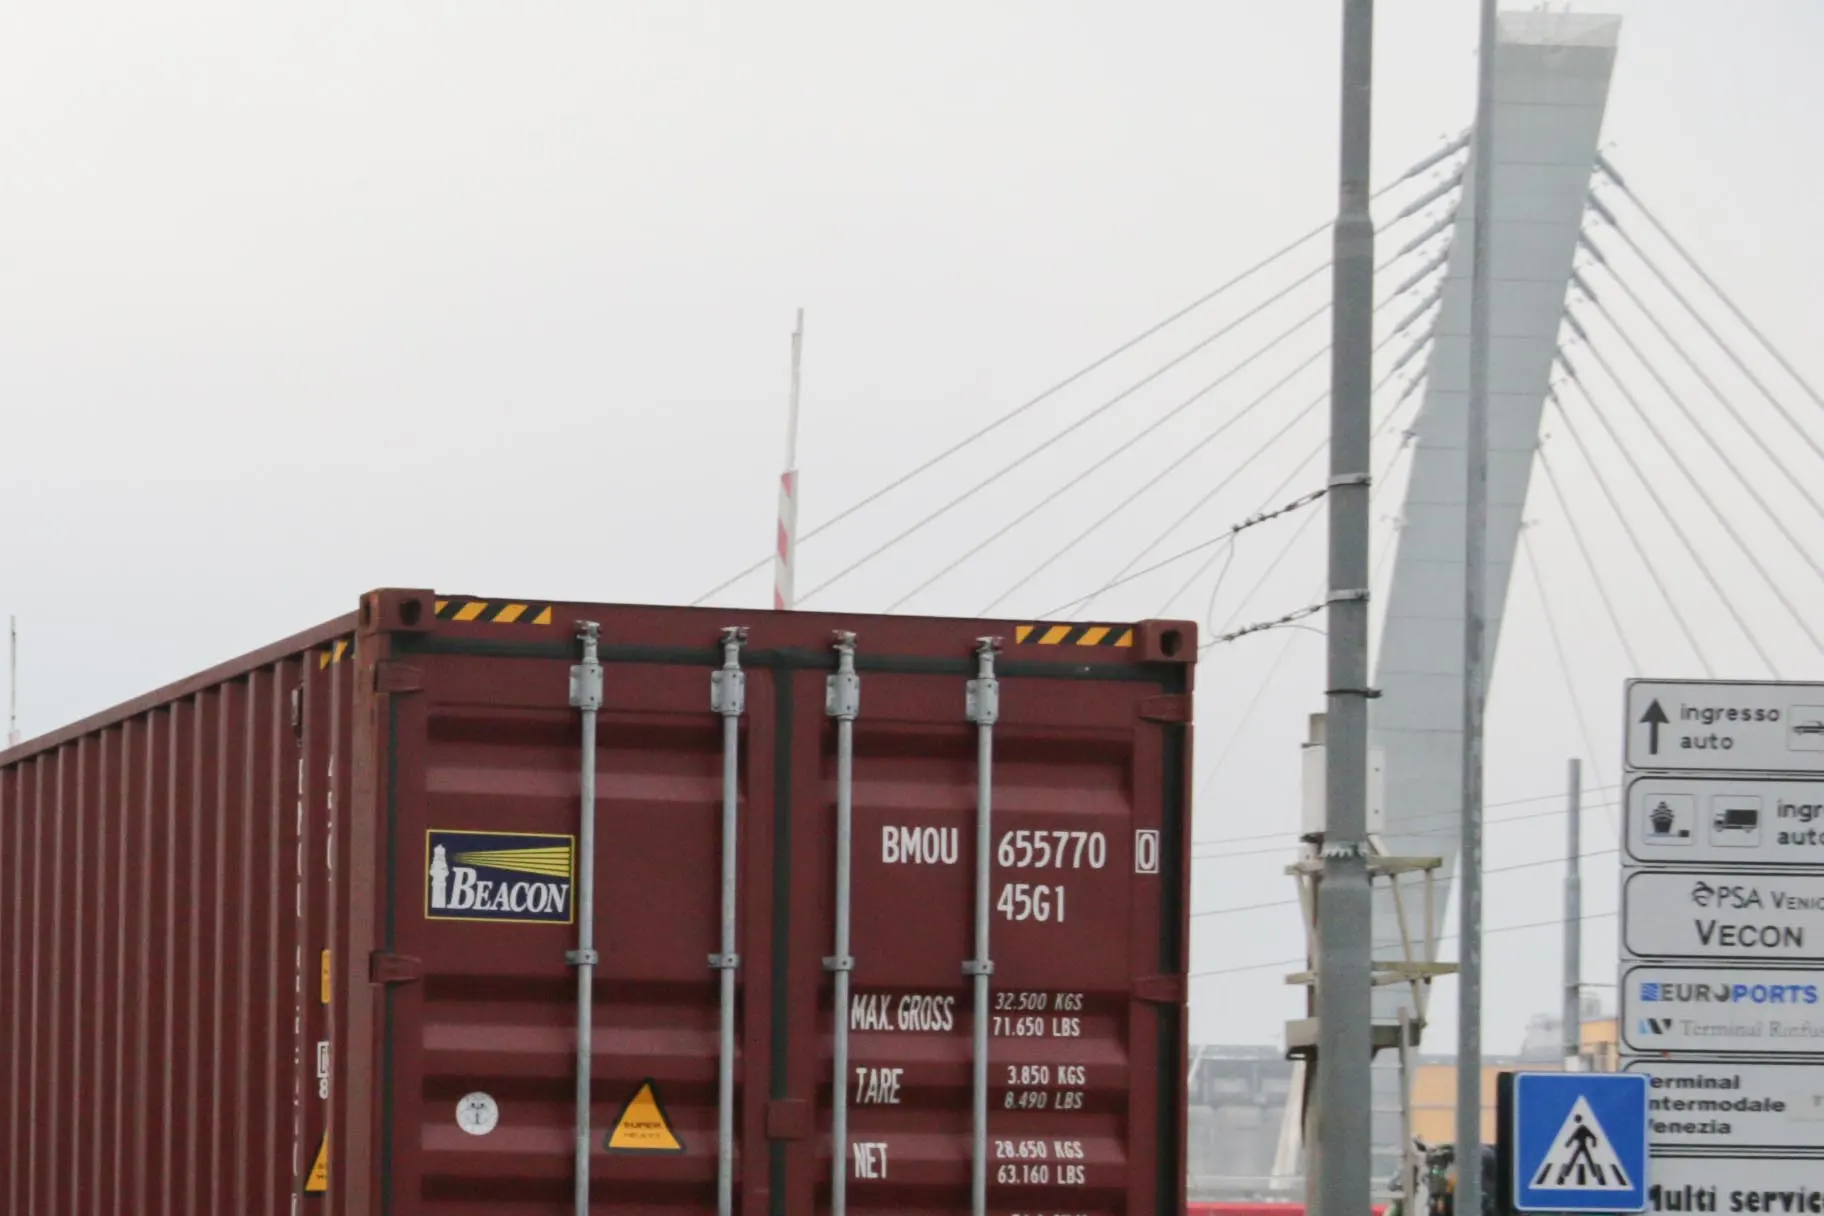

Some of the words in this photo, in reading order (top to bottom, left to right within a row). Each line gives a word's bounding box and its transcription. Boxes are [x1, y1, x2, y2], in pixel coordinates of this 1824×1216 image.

[1680, 703, 1780, 725] ingresso
[1680, 734, 1734, 750] auto
[882, 826, 959, 864] BMOU
[997, 831, 1107, 869] 655770
[447, 866, 570, 913] BEACON
[1716, 885, 1764, 909] PSA
[997, 884, 1066, 922] 45G1
[1695, 919, 1804, 948] VECON
[995, 992, 1047, 1011] 32.500
[1055, 992, 1084, 1011] KGS
[851, 994, 894, 1031] MAX.
[898, 995, 955, 1031] GROSS
[993, 1016, 1044, 1036] 71.650
[1052, 1017, 1081, 1037] LBS
[855, 1067, 904, 1104] TARE
[1007, 1065, 1049, 1085] 3.850
[1057, 1066, 1086, 1085] KGS
[1650, 1074, 1741, 1090] erminal
[1004, 1091, 1048, 1109] 8.490
[1054, 1091, 1084, 1109] LBS
[1649, 1096, 1786, 1113] ntermodale
[1649, 1118, 1733, 1135] enezia
[853, 1142, 888, 1179] NET
[994, 1140, 1047, 1159] 28.650
[1053, 1140, 1085, 1160] KGS
[997, 1164, 1049, 1184] 63.160
[1057, 1164, 1085, 1184] LBS
